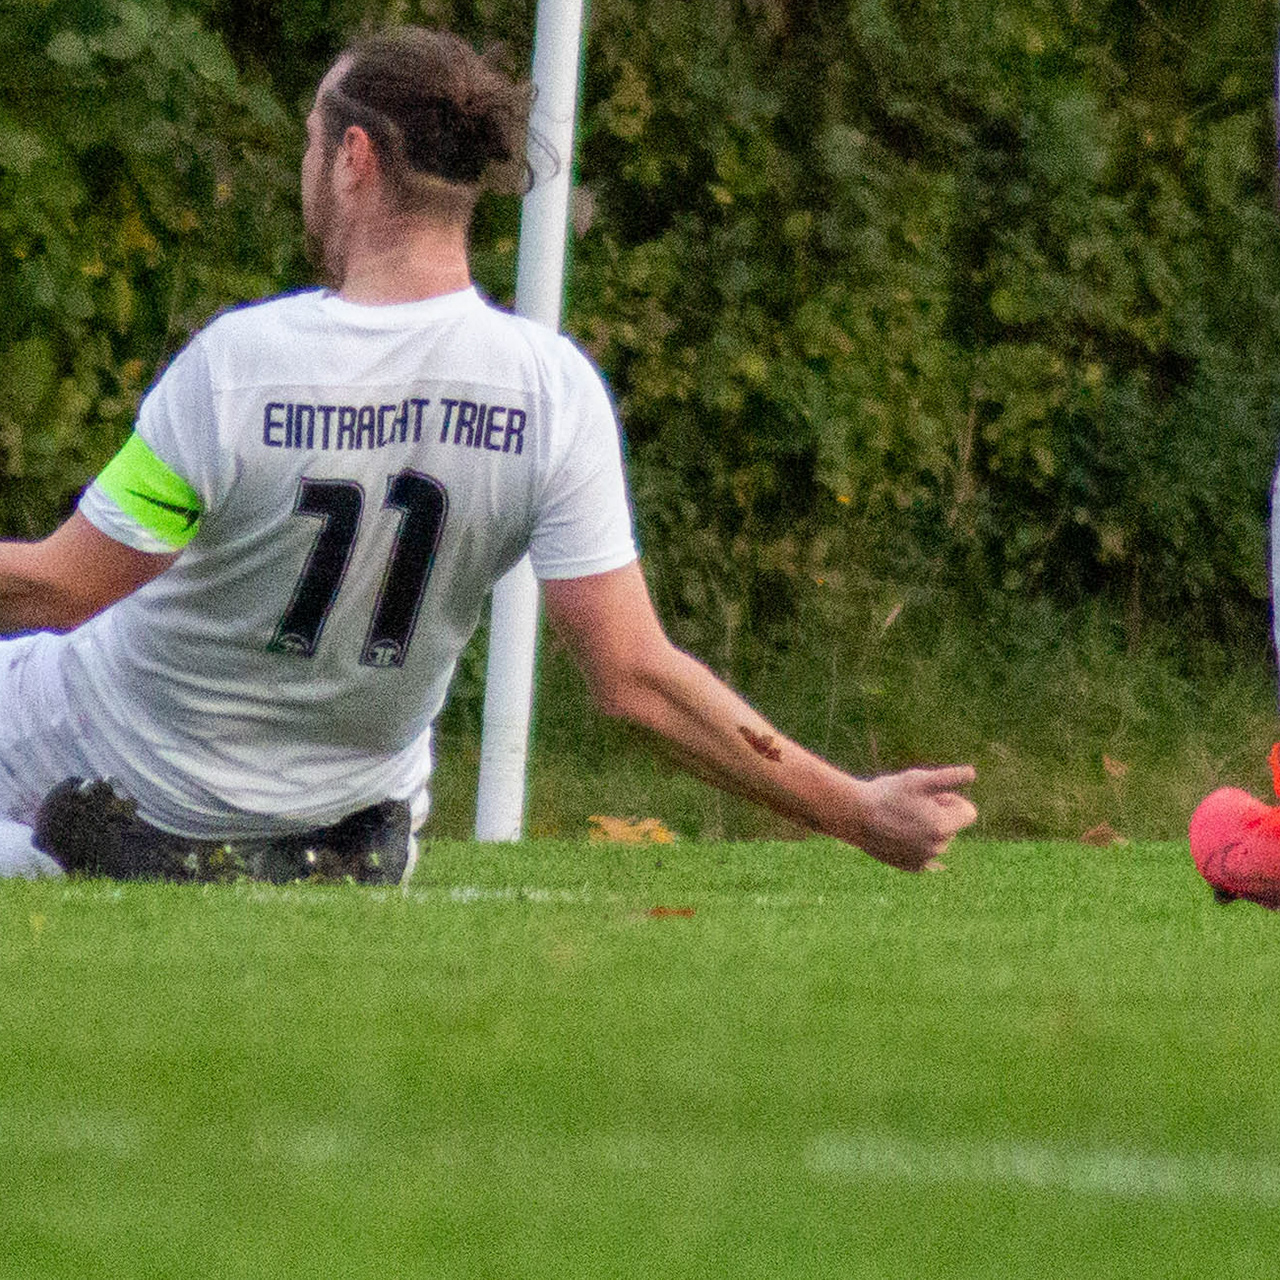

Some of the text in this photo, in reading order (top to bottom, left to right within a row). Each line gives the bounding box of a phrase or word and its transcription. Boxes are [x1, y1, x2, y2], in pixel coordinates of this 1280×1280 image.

[262, 398, 527, 455] EINTRACHT TRIER
[266, 466, 450, 668] 11
